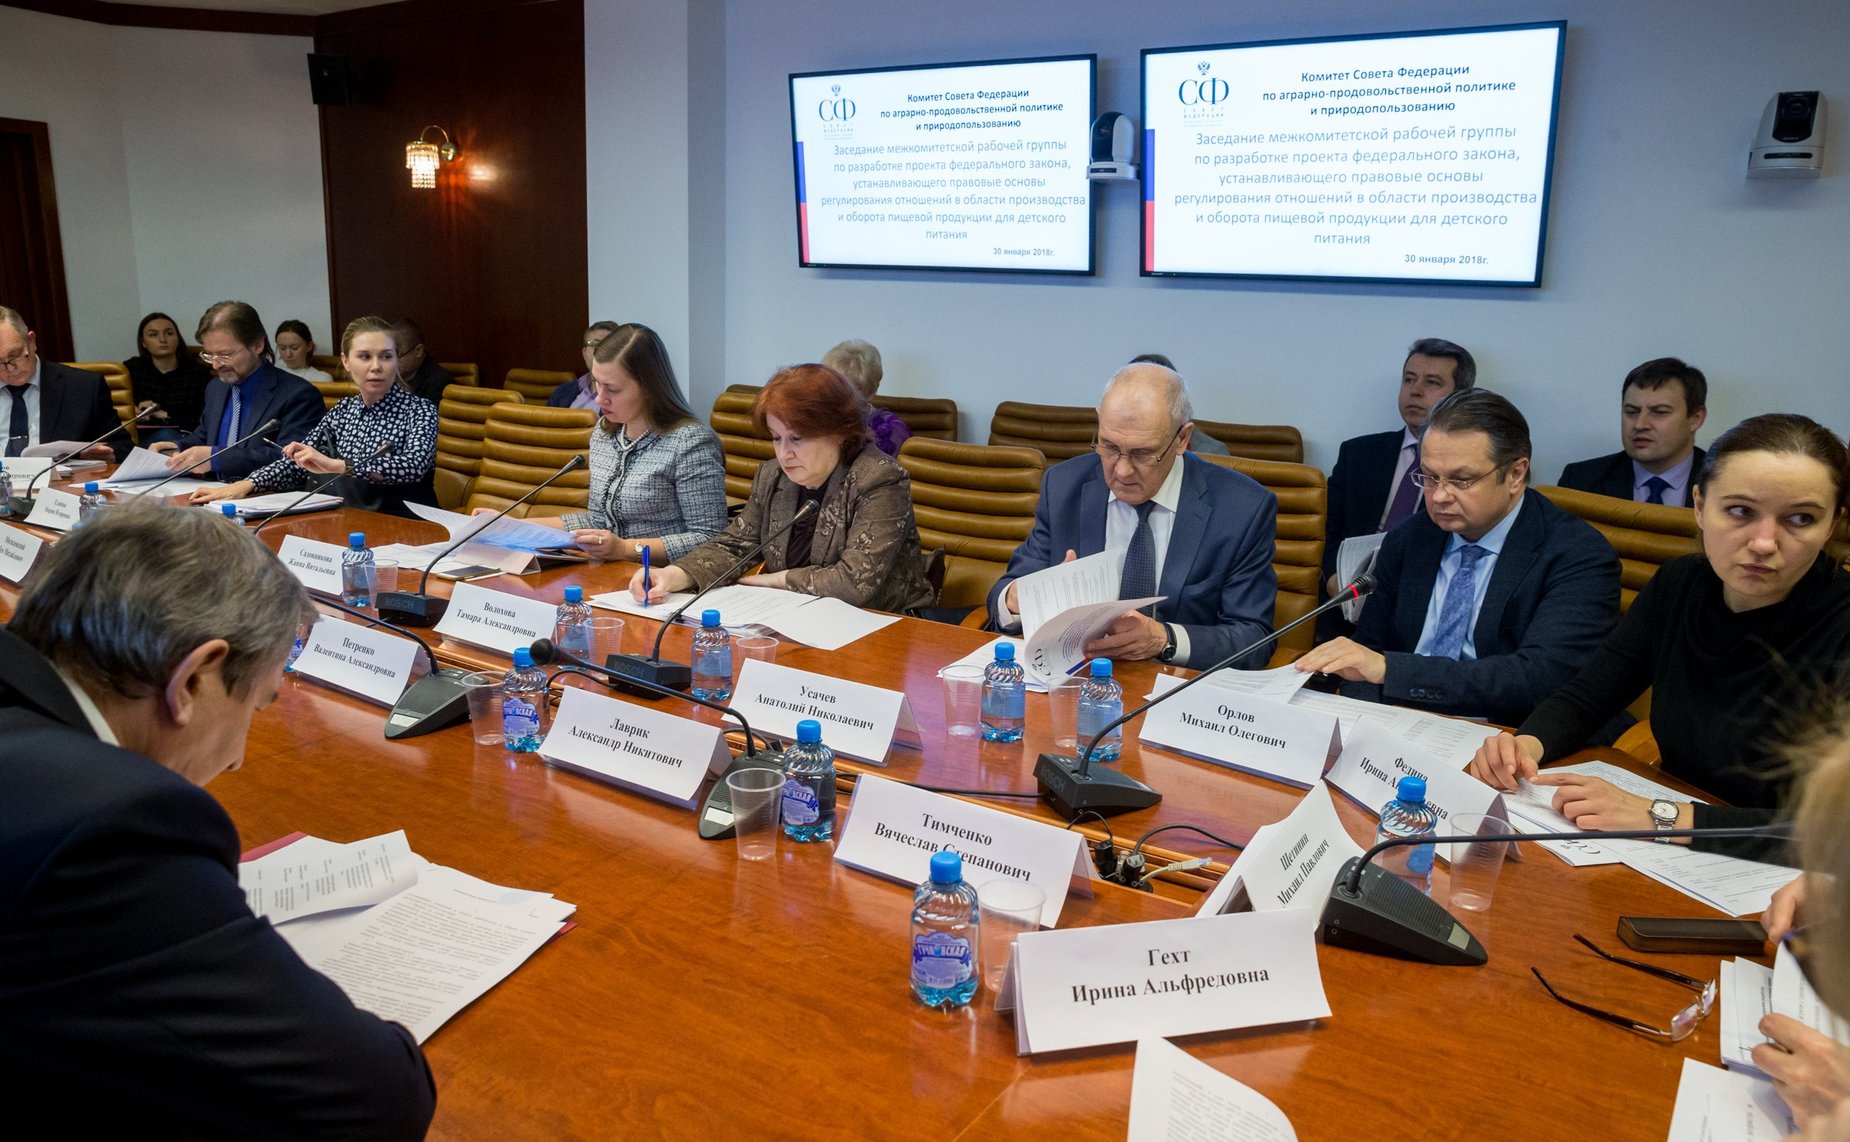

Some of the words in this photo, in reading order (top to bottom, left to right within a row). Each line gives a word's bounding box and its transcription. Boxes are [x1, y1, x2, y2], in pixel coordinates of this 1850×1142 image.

[1301, 72, 1350, 82] Комитет
[1352, 69, 1394, 80] Совета
[1397, 66, 1470, 79] Федерации
[907, 93, 943, 103] Комитет
[944, 91, 975, 101] Совета
[976, 90, 1029, 100] Федерации
[1178, 77, 1230, 105] СФ
[1262, 92, 1277, 101] по
[1278, 81, 1452, 102] аграрно-продовольственной
[1455, 81, 1516, 93] политике
[818, 97, 856, 122] СФ
[880, 110, 891, 118] по
[892, 102, 1018, 119] аграрно-продовольственной
[1019, 103, 1064, 113] политике
[1310, 107, 1318, 115] и
[1320, 102, 1456, 117] природопользованию
[915, 123, 922, 131] и
[923, 119, 1022, 132] природопользованию
[1195, 132, 1265, 147] Заседание
[1268, 127, 1388, 143] межкомитетской
[1392, 124, 1456, 143] рабочей
[1460, 127, 1516, 141] группы
[833, 144, 885, 157] Заседание
[886, 140, 975, 154] межкомитетской
[977, 138, 1023, 155] рабочей
[1026, 140, 1067, 153] группы
[833, 163, 846, 173] по
[847, 159, 903, 175] разработке
[905, 161, 947, 173] проекта
[948, 158, 1027, 172] федерального
[1028, 159, 1071, 172] закона,
[1194, 155, 1210, 165] по
[1213, 150, 1289, 167] разработке
[1292, 152, 1348, 166] проекта
[1351, 148, 1458, 165] федерального
[1462, 148, 1520, 163] закона,
[852, 178, 947, 191] устанавливающего
[949, 176, 1003, 190] правовые
[1004, 177, 1046, 189] основы
[1218, 172, 1347, 187] устанавливающего
[1351, 172, 1423, 185] правовые
[1426, 171, 1483, 183] основы
[820, 196, 893, 208] регулирования
[894, 193, 952, 206] отношений
[954, 196, 962, 206] в
[963, 192, 1007, 207] области
[1008, 195, 1087, 207] производства
[1174, 194, 1271, 207] регулирования
[1274, 190, 1353, 204] отношений
[1356, 193, 1365, 204] в
[1368, 189, 1427, 204] области
[1431, 192, 1537, 207] производства
[837, 213, 844, 222] и
[845, 210, 886, 224] оборота
[887, 210, 933, 224] пищевой
[935, 213, 993, 225] продукции
[994, 213, 1015, 225] для
[1016, 213, 1067, 225] детского
[1195, 214, 1204, 223] и
[1206, 210, 1260, 226] оборота
[1263, 211, 1325, 226] пищевой
[1328, 214, 1406, 227] продукции
[1409, 214, 1437, 227] для
[1440, 214, 1508, 227] детского
[925, 230, 968, 240] питания
[1313, 234, 1371, 245] питания
[992, 247, 1002, 255] 30
[1002, 248, 1031, 257] января
[1032, 247, 1057, 257] 2018г.
[1404, 253, 1416, 263] 30
[1418, 255, 1456, 266] января
[1458, 254, 1490, 265] 2018г.
[483, 602, 517, 618] Волохова
[456, 608, 482, 623] Тамара
[482, 616, 537, 638] Александровна
[342, 637, 375, 656] Петренко
[313, 643, 347, 662] Валентина
[346, 655, 396, 678] Александровна
[799, 684, 837, 704] Усачев
[754, 693, 806, 716] Анатолий
[807, 705, 875, 731] Николаевич
[1217, 704, 1256, 723] Орлов
[610, 717, 651, 739] Лаврик
[1179, 712, 1226, 734] Михаил
[1228, 724, 1287, 749] Олегович
[568, 725, 622, 751] Александр
[622, 740, 683, 769] Никитович
[1359, 757, 1389, 783] Ирина
[873, 822, 939, 853] Вячеслав
[921, 813, 993, 846] Тимченко
[1280, 833, 1310, 871] Щетинин
[1277, 873, 1305, 906] Михаил
[1299, 838, 1330, 878] Павлович
[1147, 948, 1191, 966] Гехт
[1071, 983, 1137, 1005] Ирина
[1143, 968, 1270, 995] Альфредовна
